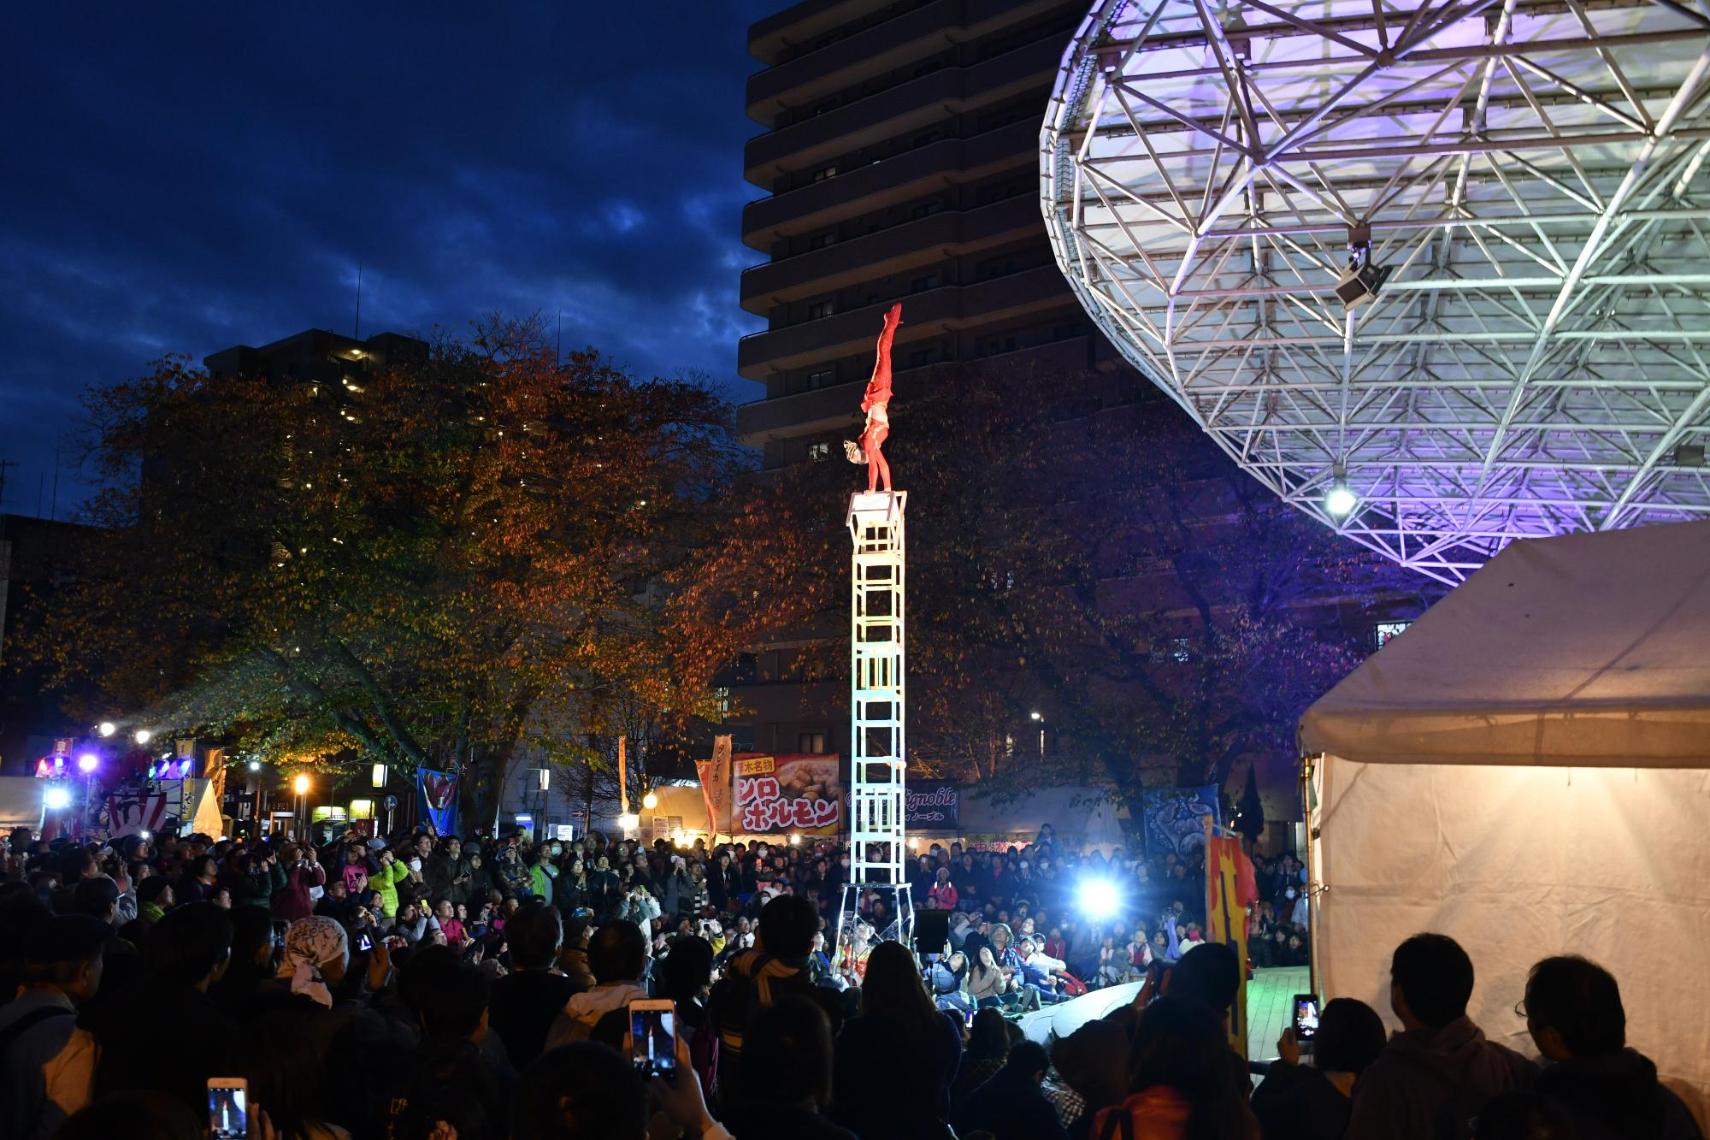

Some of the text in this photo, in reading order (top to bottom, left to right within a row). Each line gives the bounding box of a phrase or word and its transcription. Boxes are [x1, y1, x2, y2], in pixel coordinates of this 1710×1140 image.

[904, 786, 957, 812] ignoble
[743, 798, 839, 832] ホルモン
